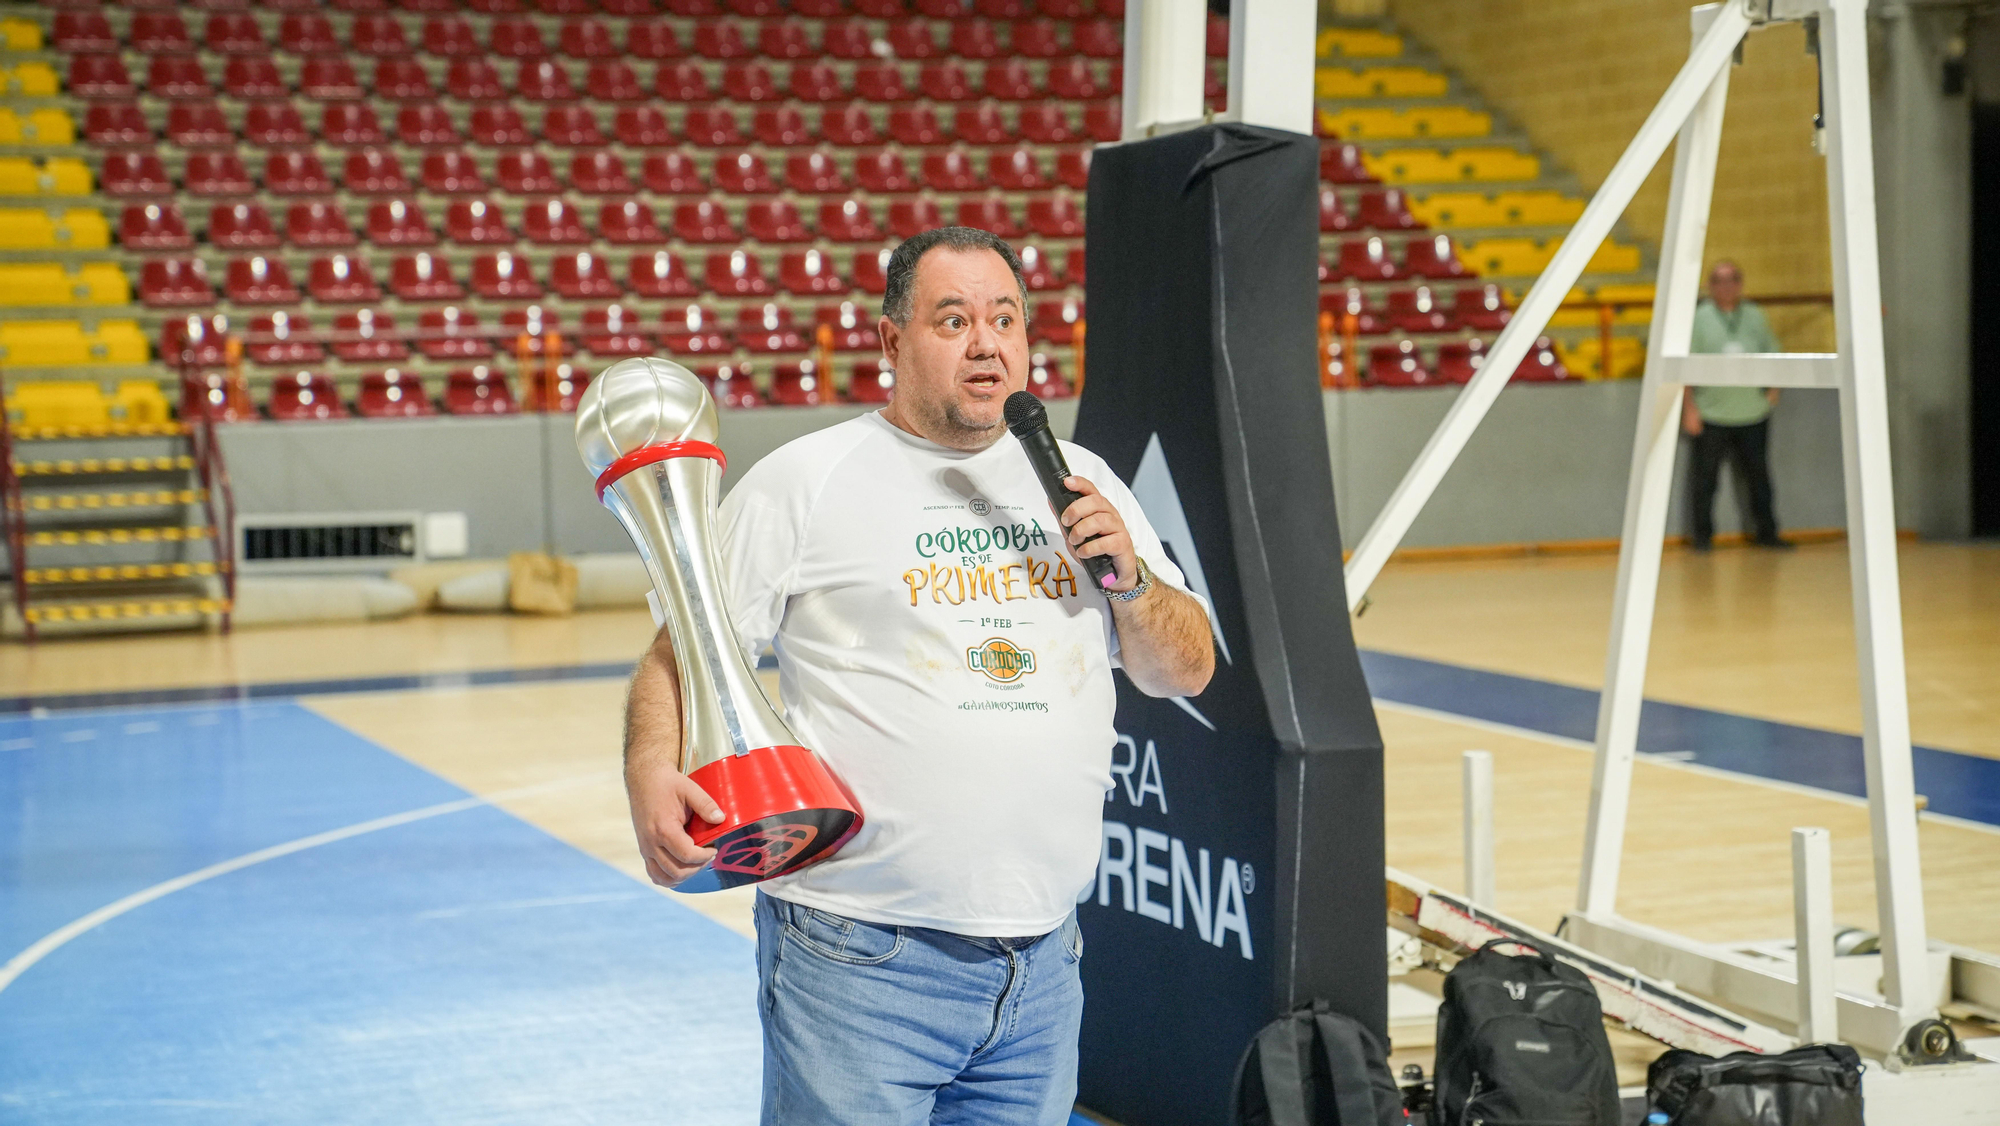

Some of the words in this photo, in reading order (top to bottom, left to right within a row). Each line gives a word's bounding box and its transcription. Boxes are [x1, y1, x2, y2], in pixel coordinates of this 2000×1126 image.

[915, 518, 1048, 558] CÓRDOBA
[961, 555, 976, 569] ES
[979, 553, 993, 564] DE
[902, 550, 1077, 607] PRIMERA
[993, 618, 1012, 628] FEB
[985, 681, 999, 690] COTO
[1103, 733, 1168, 814] RA
